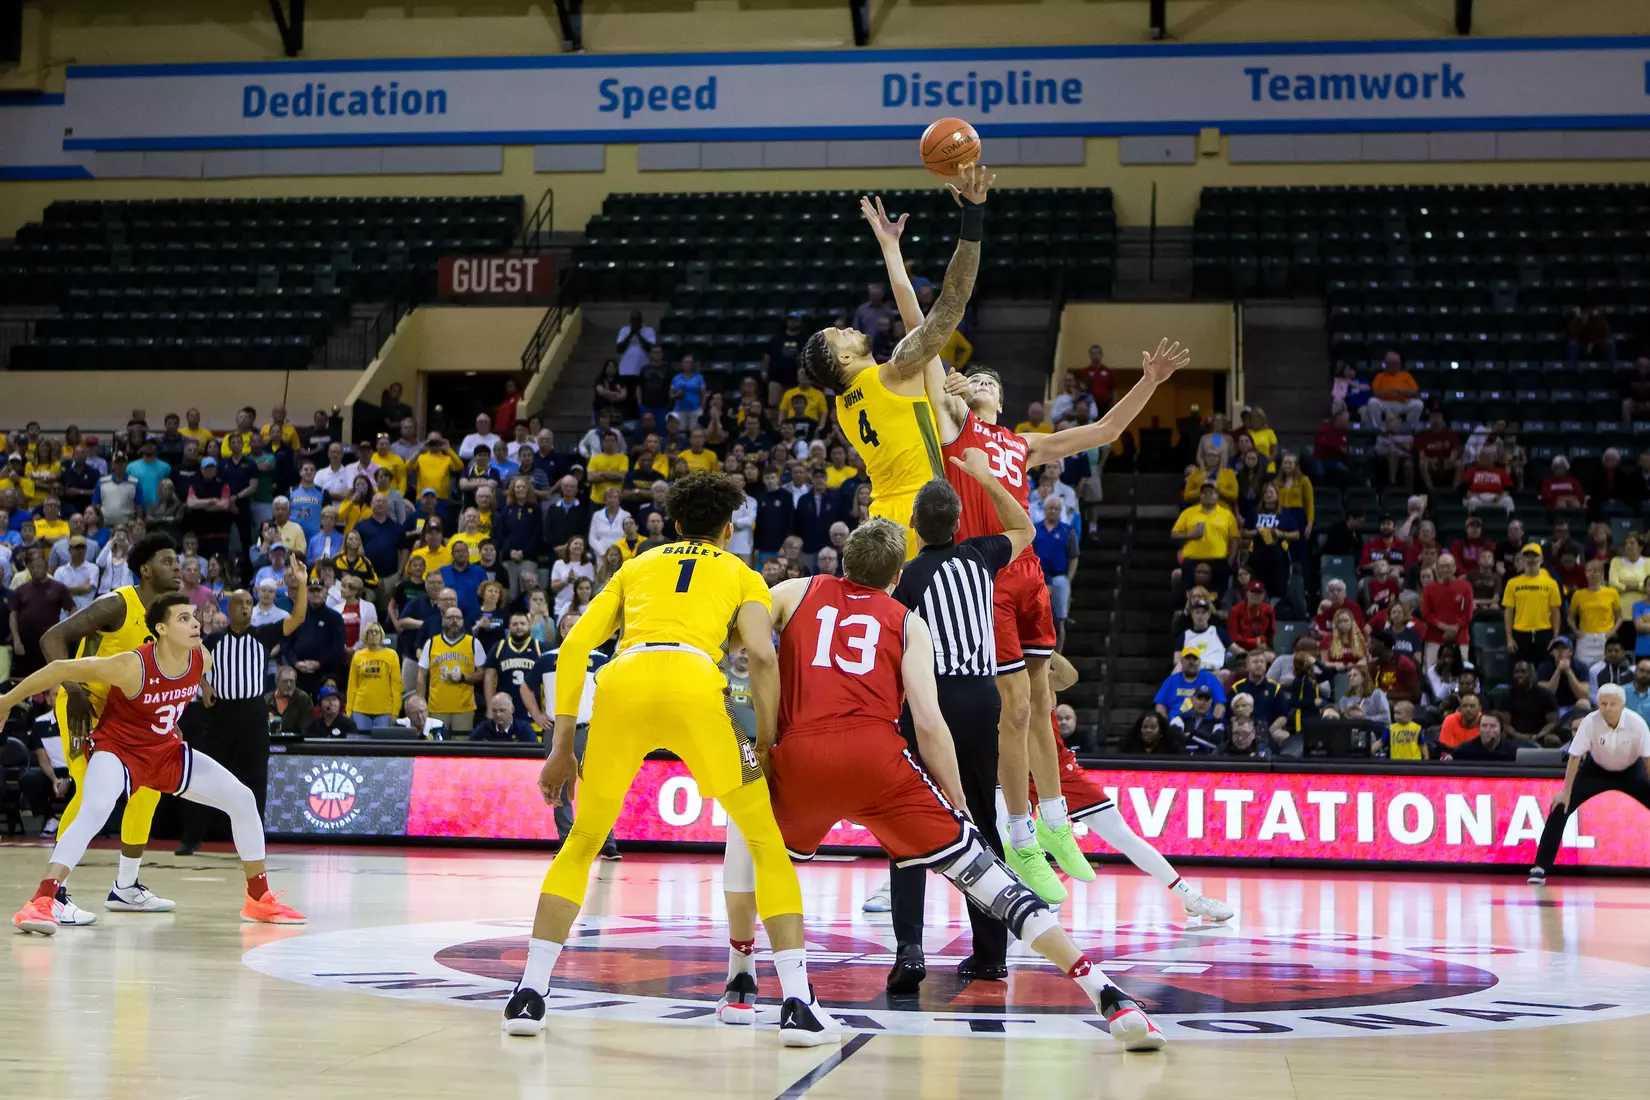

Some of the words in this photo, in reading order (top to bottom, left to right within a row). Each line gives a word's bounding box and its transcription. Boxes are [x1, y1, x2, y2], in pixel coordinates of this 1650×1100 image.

[242, 82, 447, 118] Dedication
[599, 76, 717, 119] Speed
[882, 70, 1083, 113] Discipline
[1244, 63, 1466, 102] Teamwork
[452, 257, 539, 293] GUEST
[844, 387, 864, 409] JOHN
[858, 408, 881, 448] 4
[973, 422, 1026, 454] DAISON
[985, 441, 1024, 488] 35
[663, 545, 723, 558] BAILEY
[675, 558, 698, 593] 1
[811, 605, 882, 676] 13
[500, 657, 535, 672] MARQUETT
[512, 670, 525, 685] 3
[143, 684, 199, 704] DAVIDSON
[150, 701, 187, 735] 31
[304, 760, 364, 784] ORLANDO
[1074, 786, 1596, 849] VITATIONAL
